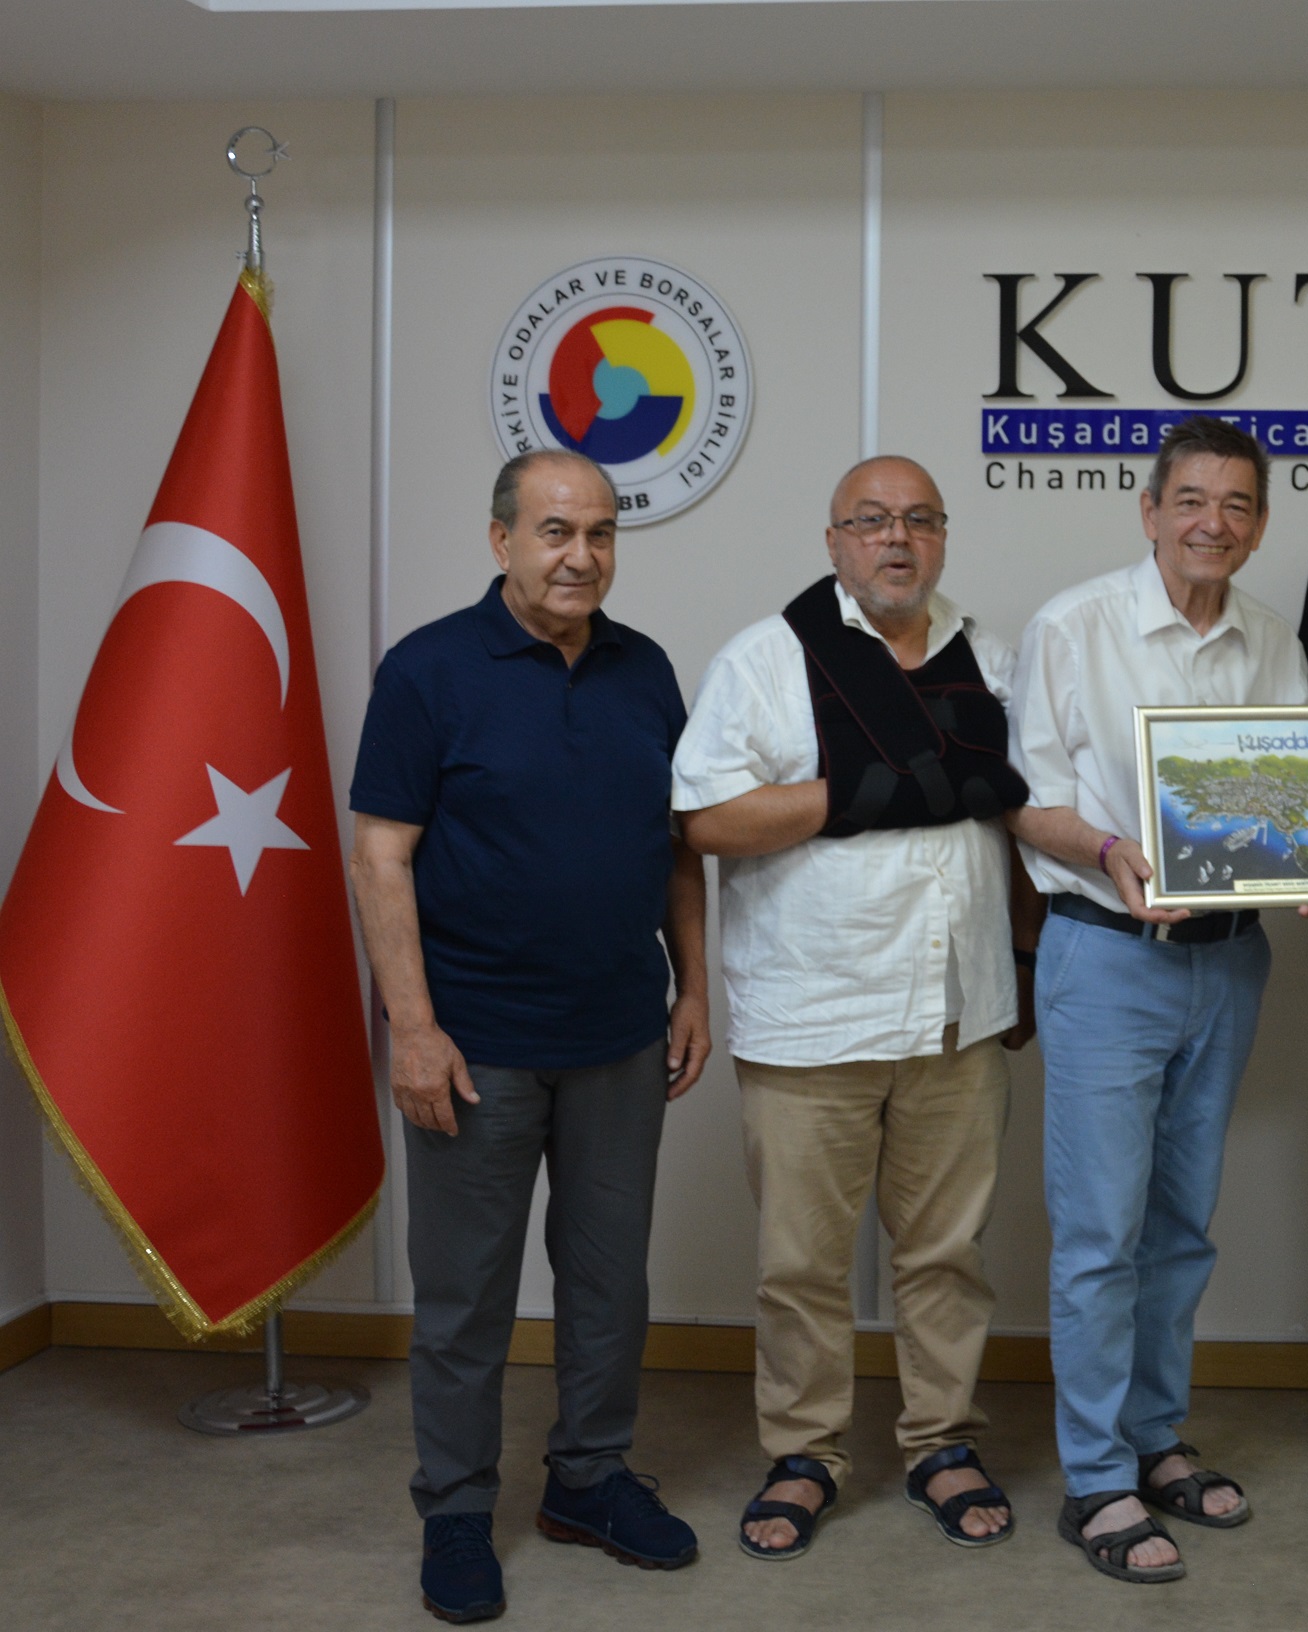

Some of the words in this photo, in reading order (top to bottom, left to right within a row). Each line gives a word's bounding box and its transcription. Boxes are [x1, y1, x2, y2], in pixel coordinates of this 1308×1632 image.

[595, 269, 627, 286] VE
[508, 278, 586, 361] ODALAR
[639, 272, 735, 381] BORSALAR
[502, 373, 533, 453] RKİYE
[987, 415, 1174, 448] Kuşadas
[985, 461, 1136, 490] Chamb
